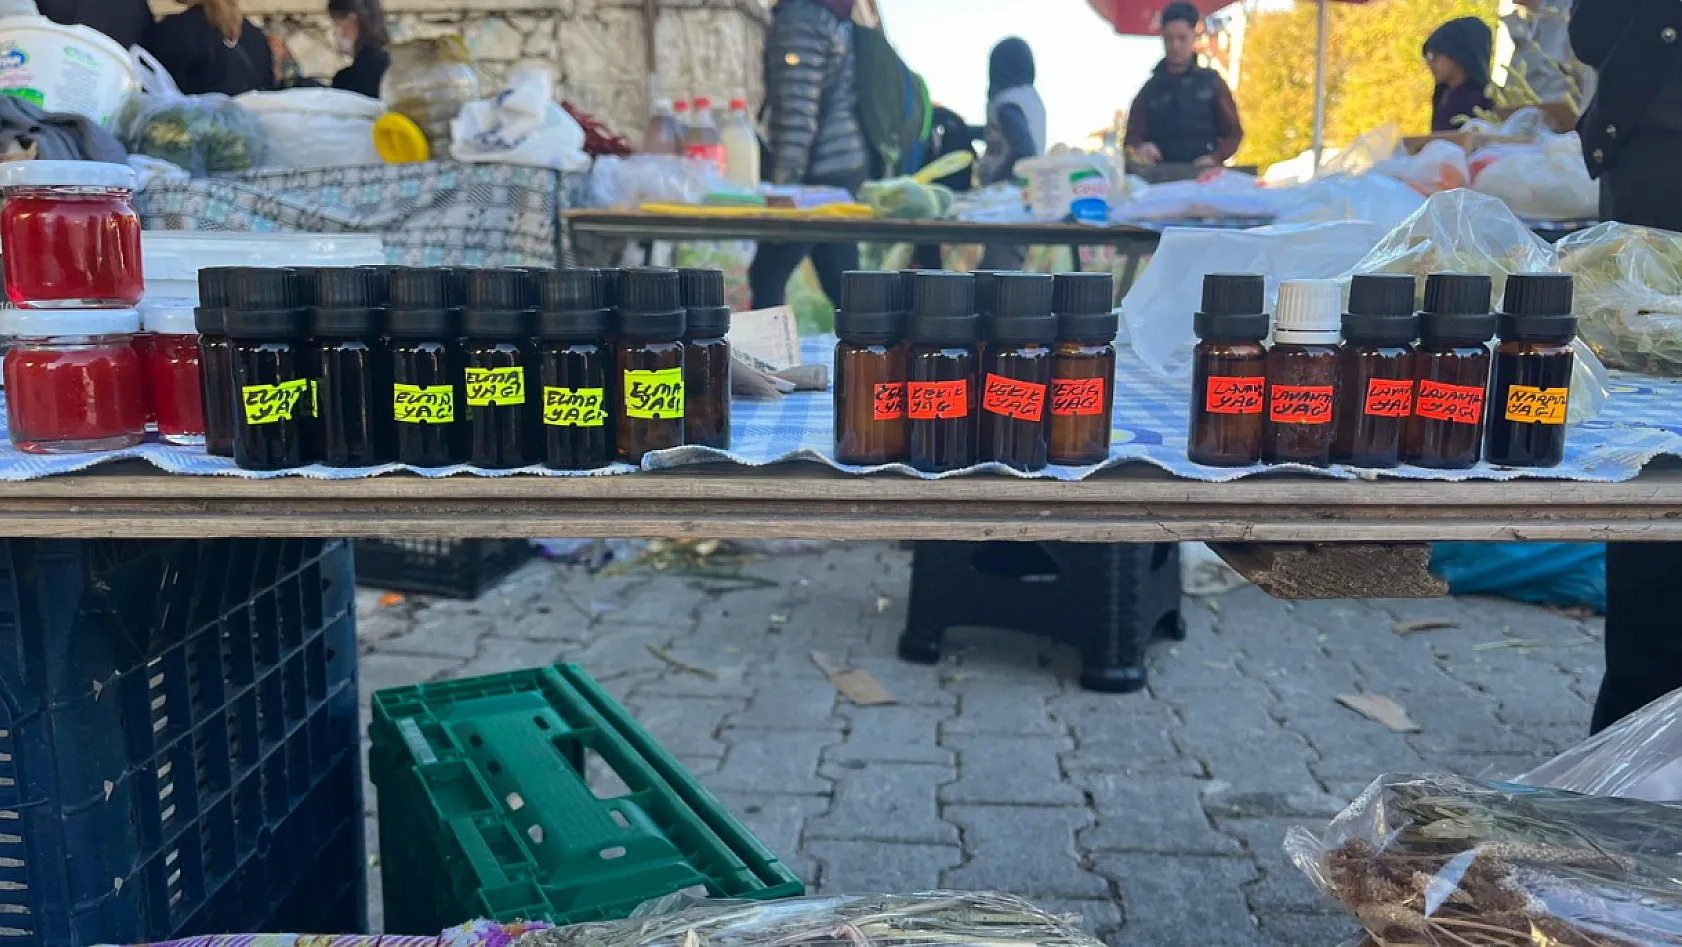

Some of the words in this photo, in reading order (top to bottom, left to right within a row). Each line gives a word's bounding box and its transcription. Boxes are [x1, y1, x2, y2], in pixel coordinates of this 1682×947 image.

[466, 371, 518, 384] ELMA
[396, 391, 450, 406] ELMA
[546, 390, 598, 407] ELMA
